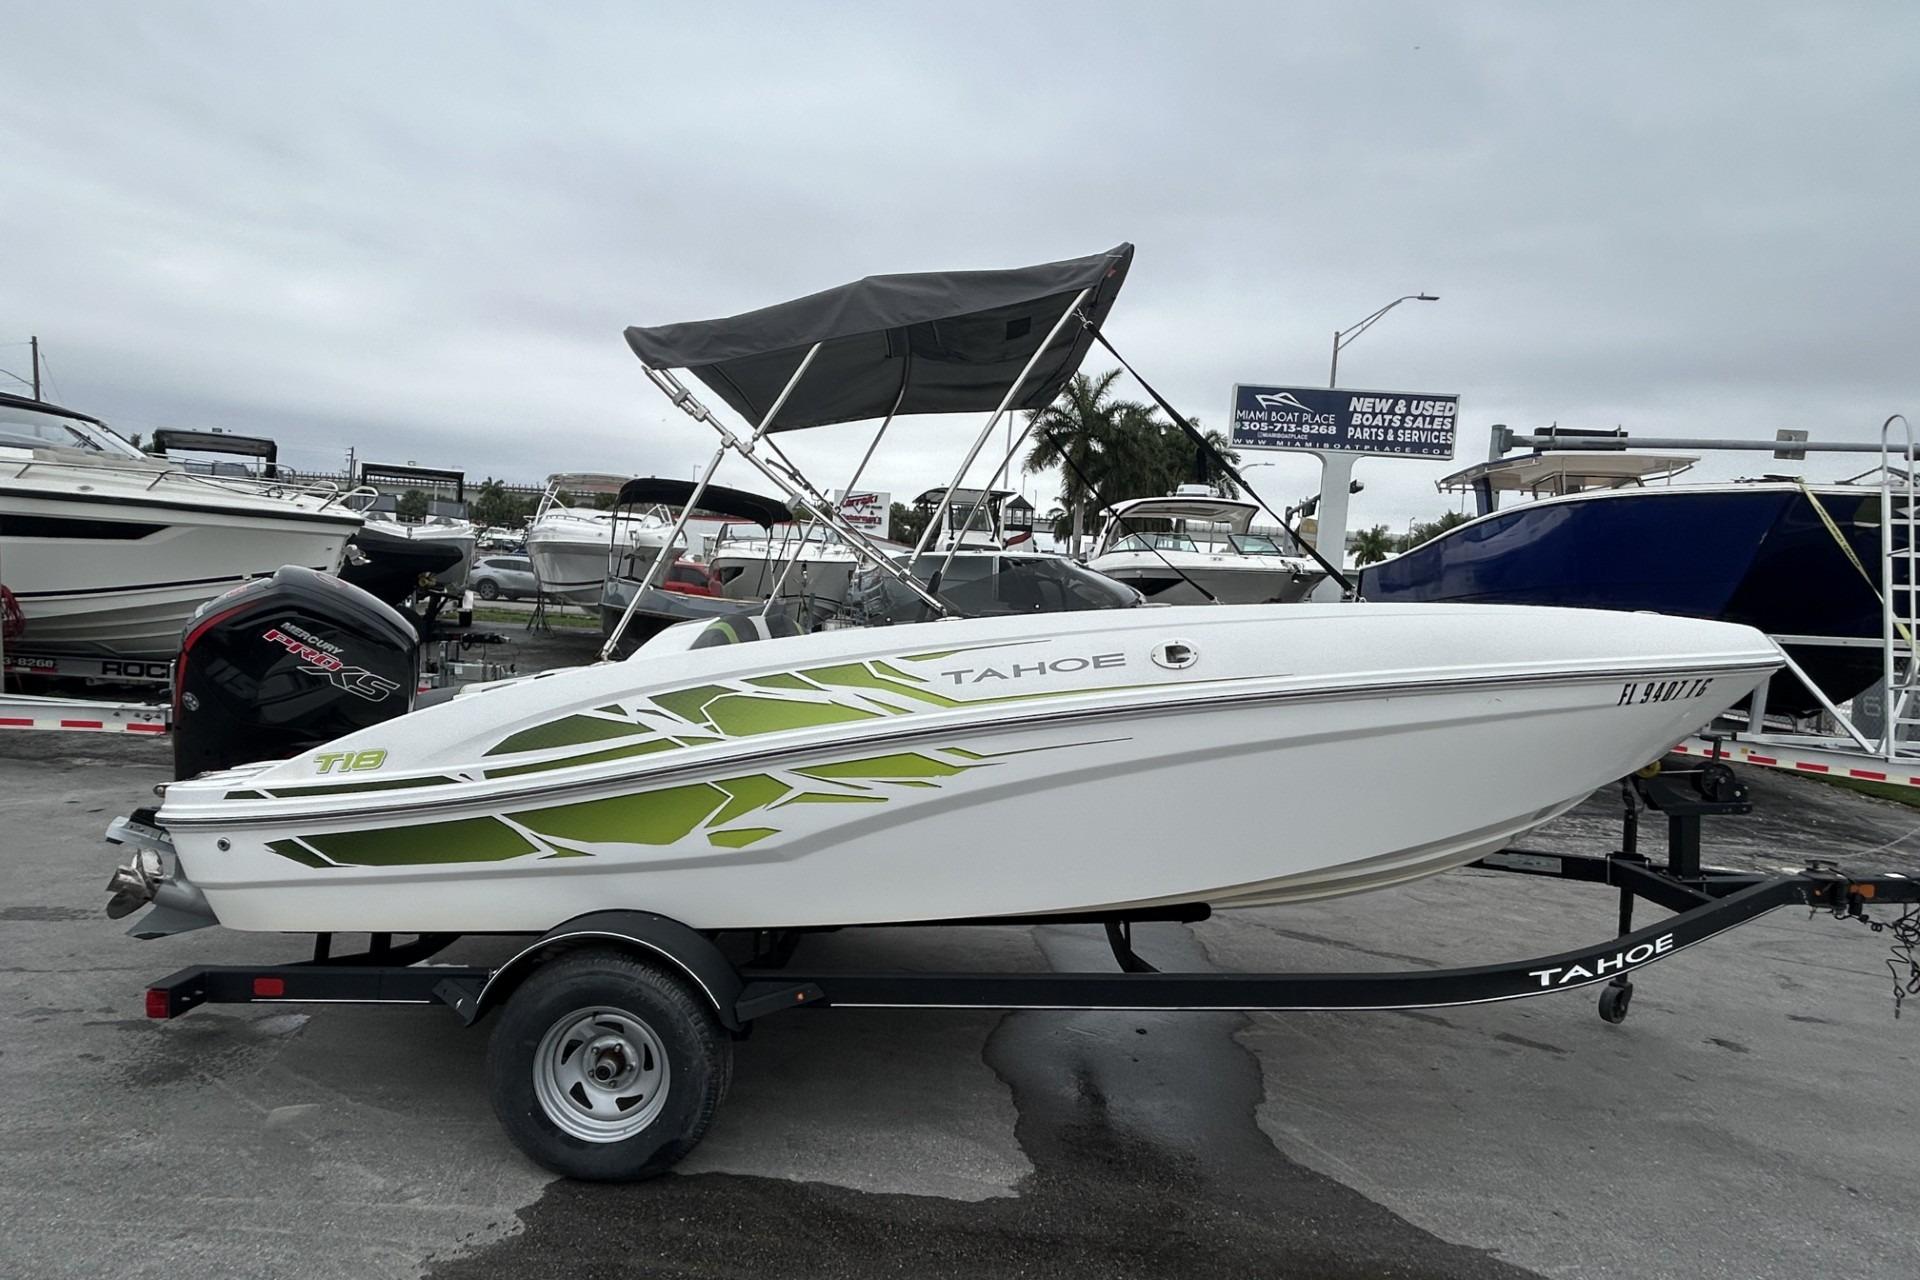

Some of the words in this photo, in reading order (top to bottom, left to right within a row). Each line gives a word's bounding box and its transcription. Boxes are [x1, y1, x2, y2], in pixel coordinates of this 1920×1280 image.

[1236, 410, 1268, 421] MIAMI
[1271, 411, 1300, 423] BOAT
[1302, 413, 1336, 425] PLACE
[1349, 397, 1393, 413] NEW
[1394, 400, 1407, 414] &
[1411, 401, 1456, 417] USED
[1241, 421, 1337, 435] 305-713-8268
[1351, 413, 1401, 427] BOATS
[1404, 416, 1452, 430] SALES
[1348, 427, 1385, 441] PARTS
[1386, 429, 1395, 441] &
[1397, 430, 1453, 445] SERVICES
[280, 621, 345, 654] MERCURY
[262, 628, 344, 672] PRO
[102, 661, 170, 679] ROC
[940, 652, 1127, 685] TAHOE
[1616, 682, 1638, 706] FL
[1638, 680, 1689, 704] 9407
[312, 748, 388, 775] T18
[1528, 932, 1674, 987] TAHOE
